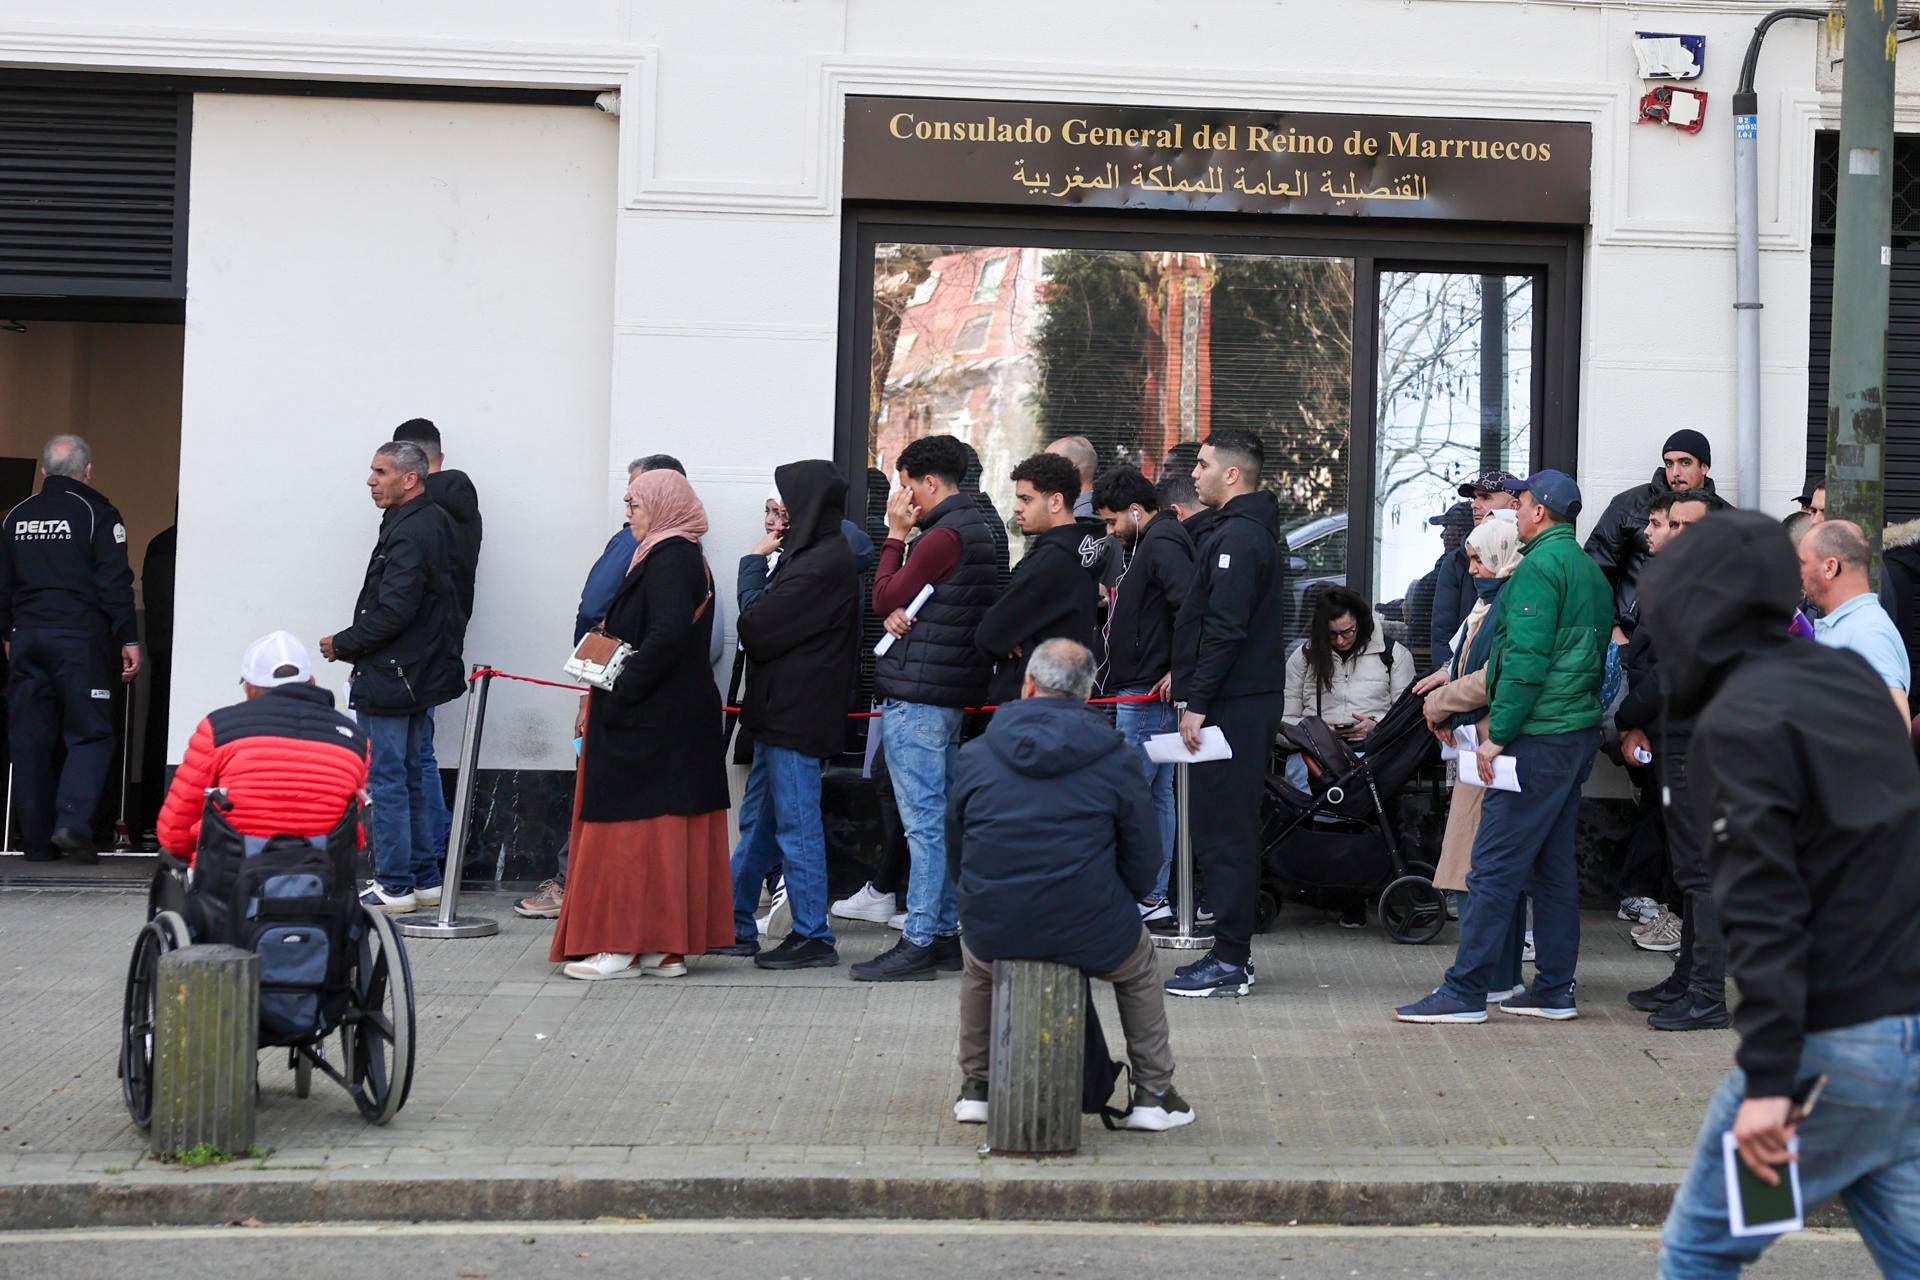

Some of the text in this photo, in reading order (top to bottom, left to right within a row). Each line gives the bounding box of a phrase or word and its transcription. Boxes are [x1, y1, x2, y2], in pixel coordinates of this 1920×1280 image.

[889, 112, 1551, 161] Consulado General del Reino de Marruecos
[1012, 158, 1428, 205] القنصلية العامة للمملكة المغربية
[15, 520, 71, 534] DELTA
